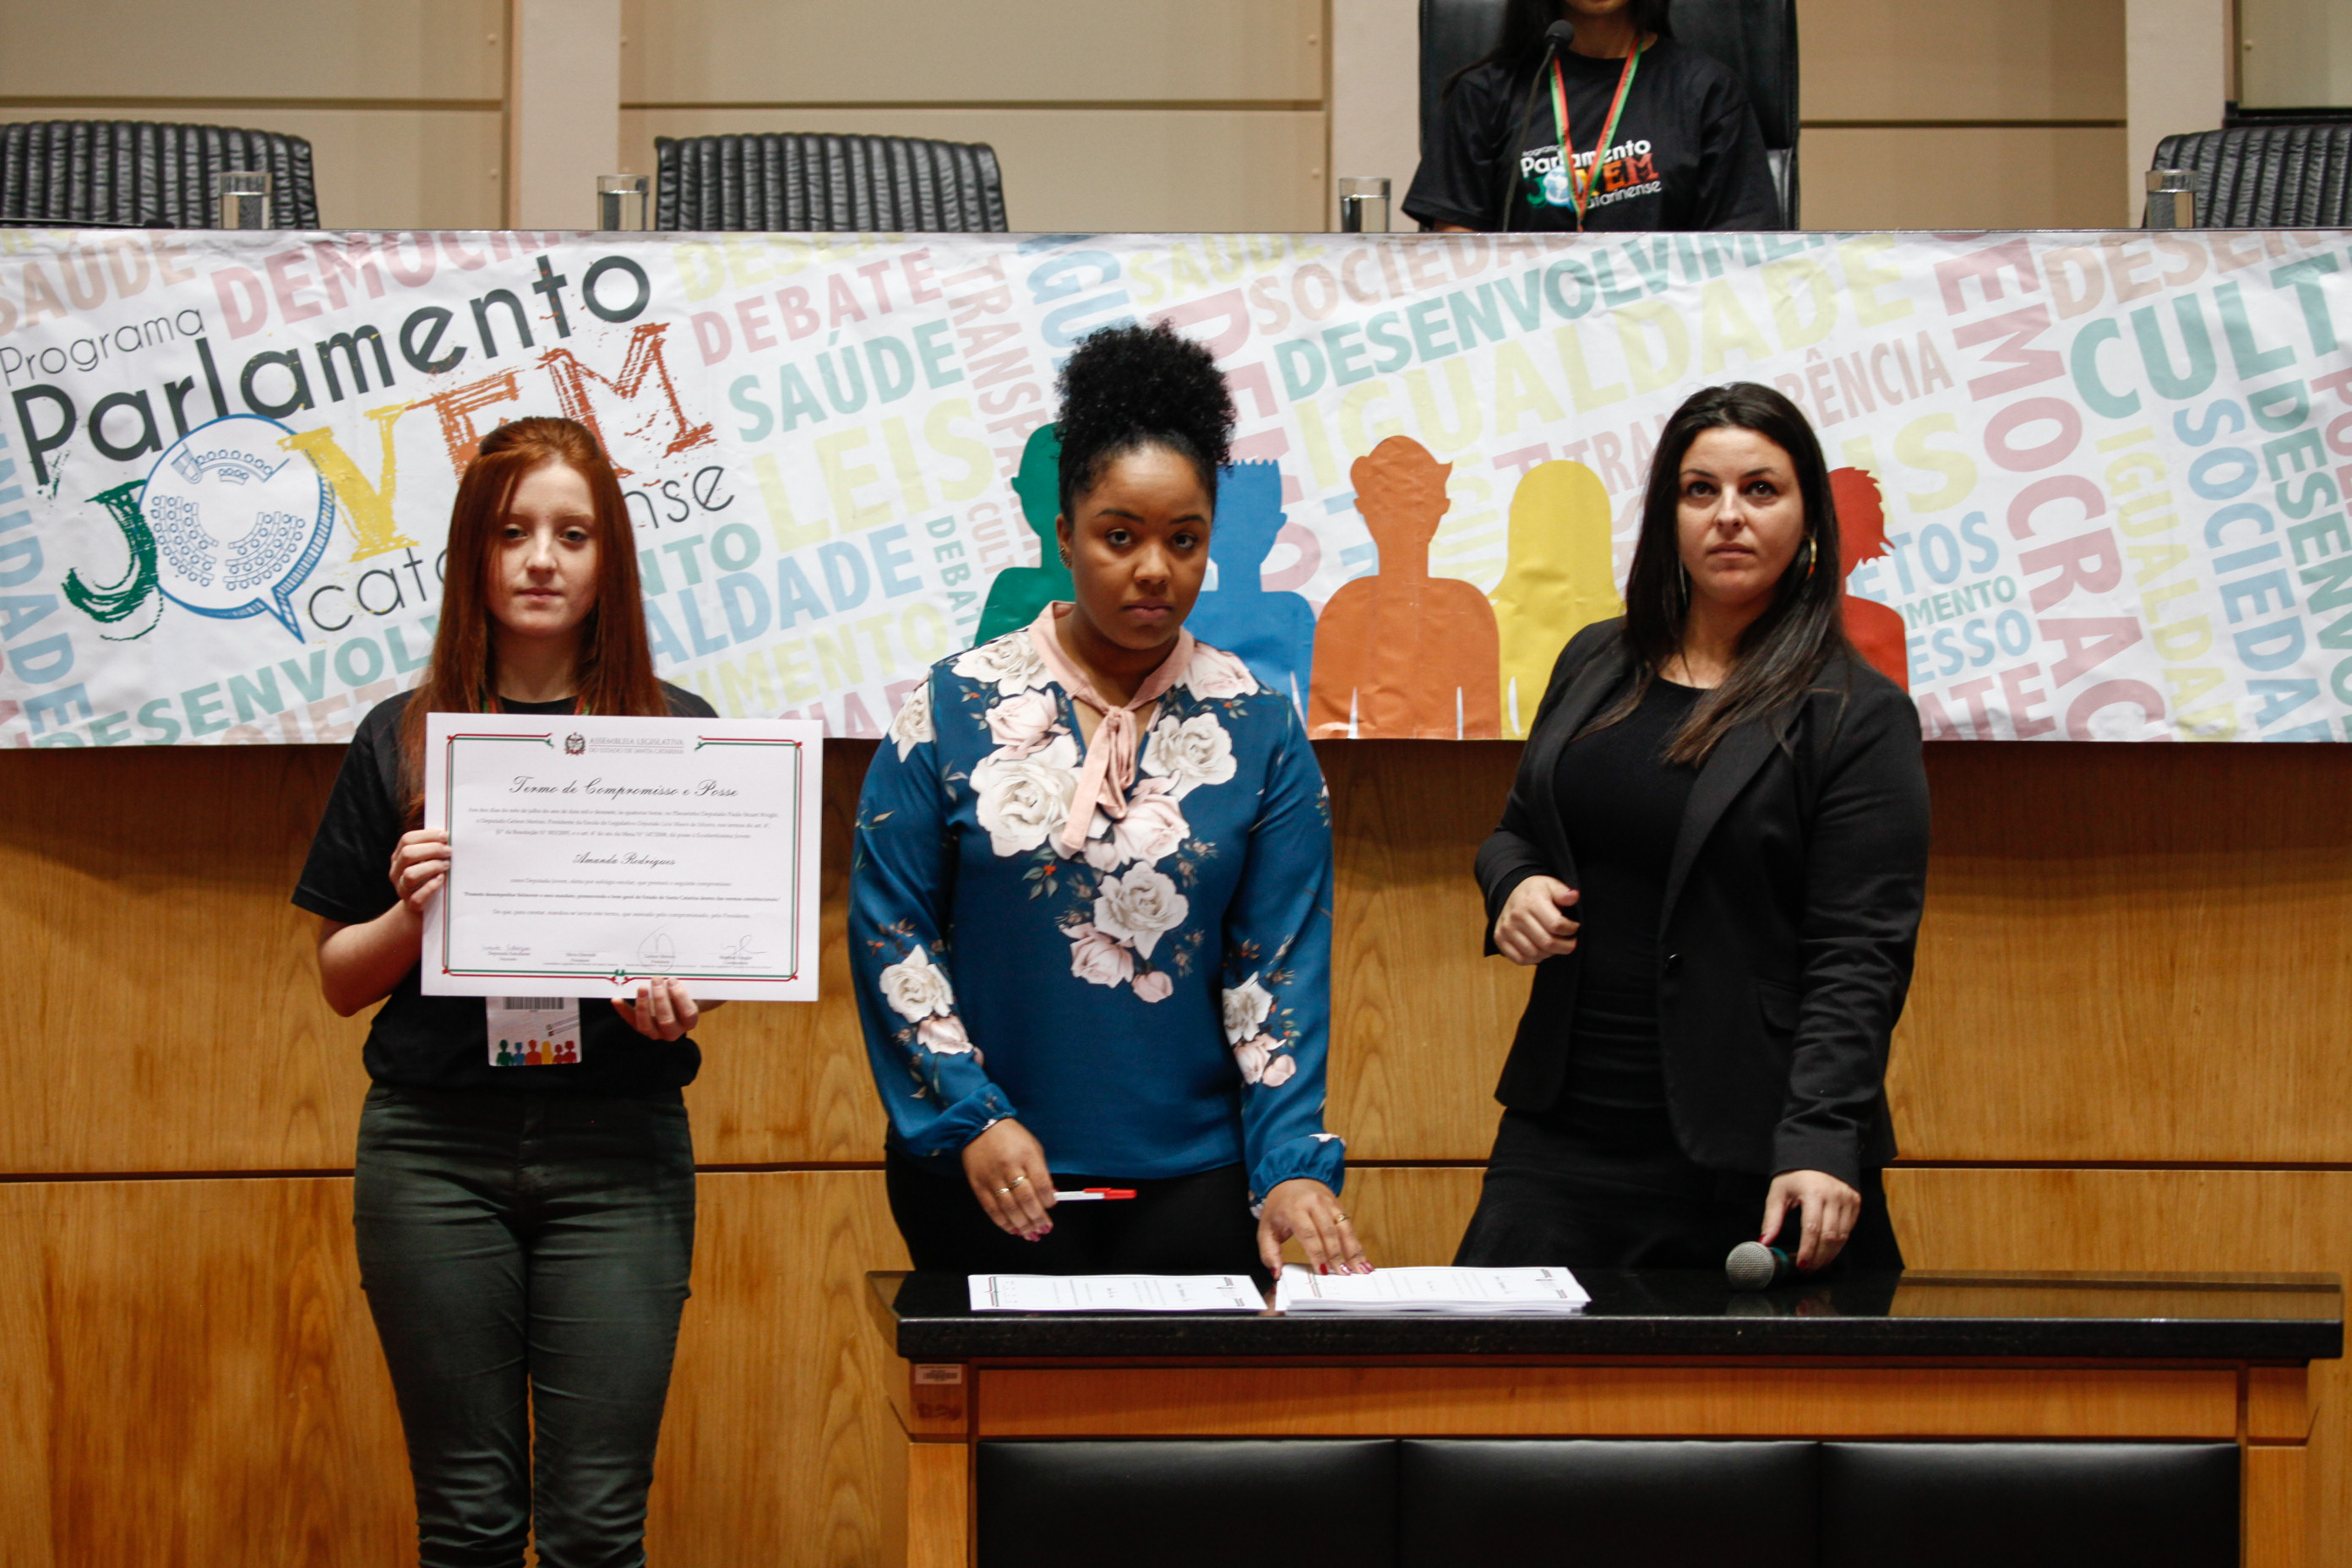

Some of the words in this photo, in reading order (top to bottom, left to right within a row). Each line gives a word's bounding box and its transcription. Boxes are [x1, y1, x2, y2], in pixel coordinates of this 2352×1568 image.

[0, 308, 205, 386] Programa
[689, 246, 944, 367] DEBATE
[11, 255, 651, 487] Parlamento
[728, 318, 965, 443] SAÚDE
[753, 397, 995, 554] LEIS
[509, 776, 558, 793] Termo
[561, 779, 578, 794] de
[583, 776, 679, 801] Compromisso
[682, 787, 690, 797] e
[694, 779, 739, 798] Posse
[572, 851, 619, 865] Amanda
[620, 852, 677, 869] Rodrigues
